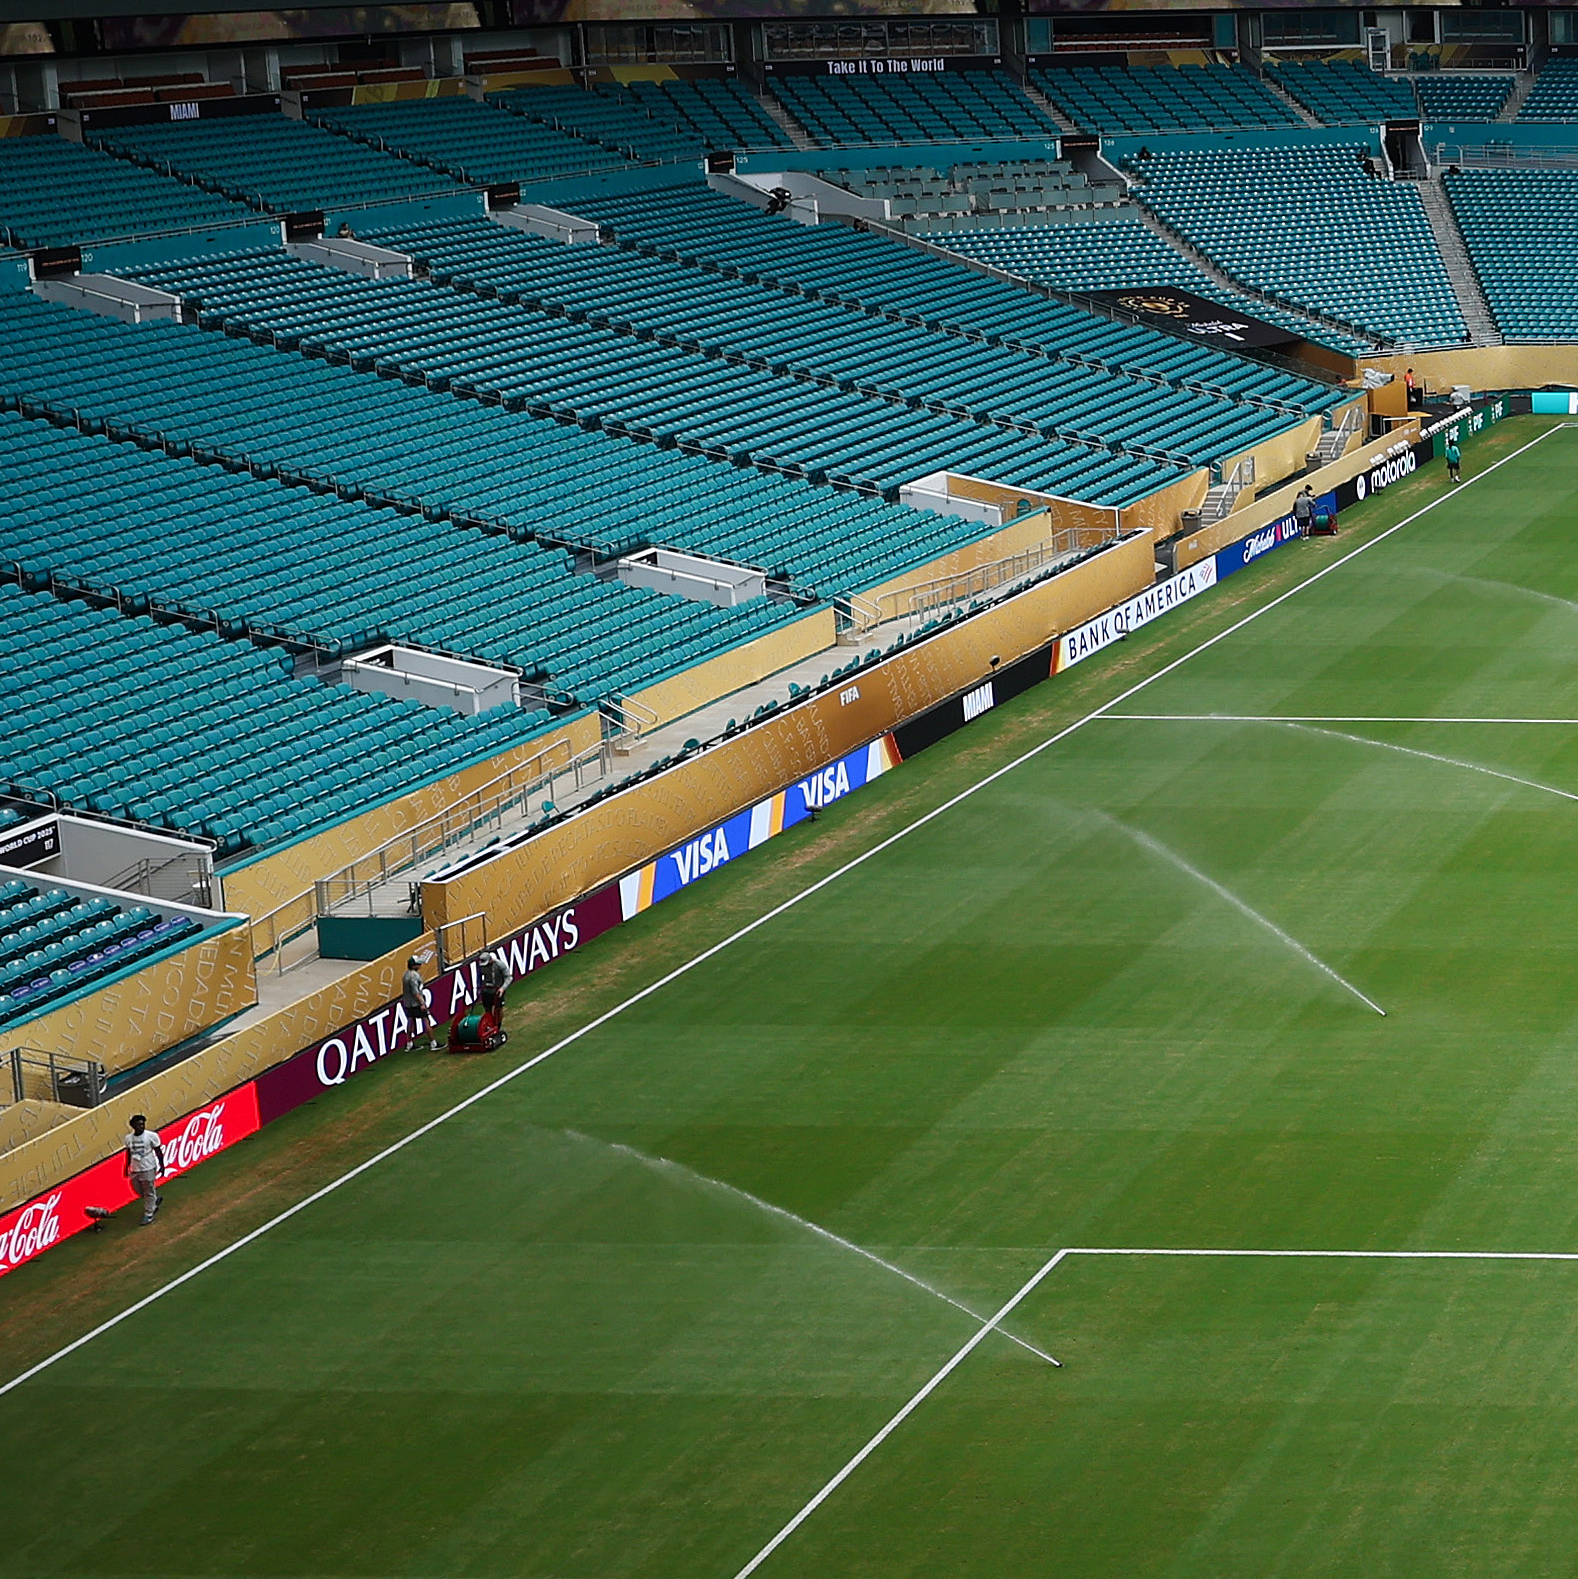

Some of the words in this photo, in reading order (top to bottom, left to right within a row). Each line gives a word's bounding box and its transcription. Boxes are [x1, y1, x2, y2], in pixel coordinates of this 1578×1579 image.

[827, 60, 856, 75] Take
[859, 60, 868, 74] It
[870, 60, 884, 73] To
[887, 59, 905, 73] The
[907, 58, 945, 73] World
[170, 103, 199, 120] MIAMI
[1473, 413, 1483, 431] PIF
[1371, 450, 1416, 493] motorola
[1068, 616, 1110, 660] BANK
[1113, 606, 1132, 634] OF
[1135, 573, 1197, 624] AMERICA
[840, 685, 860, 706] FIFA
[963, 682, 995, 721] MIAMI
[799, 761, 849, 808] VISA
[23, 833, 36, 844] CUP
[670, 827, 729, 884] VISA
[450, 909, 578, 1014] AIWAYS
